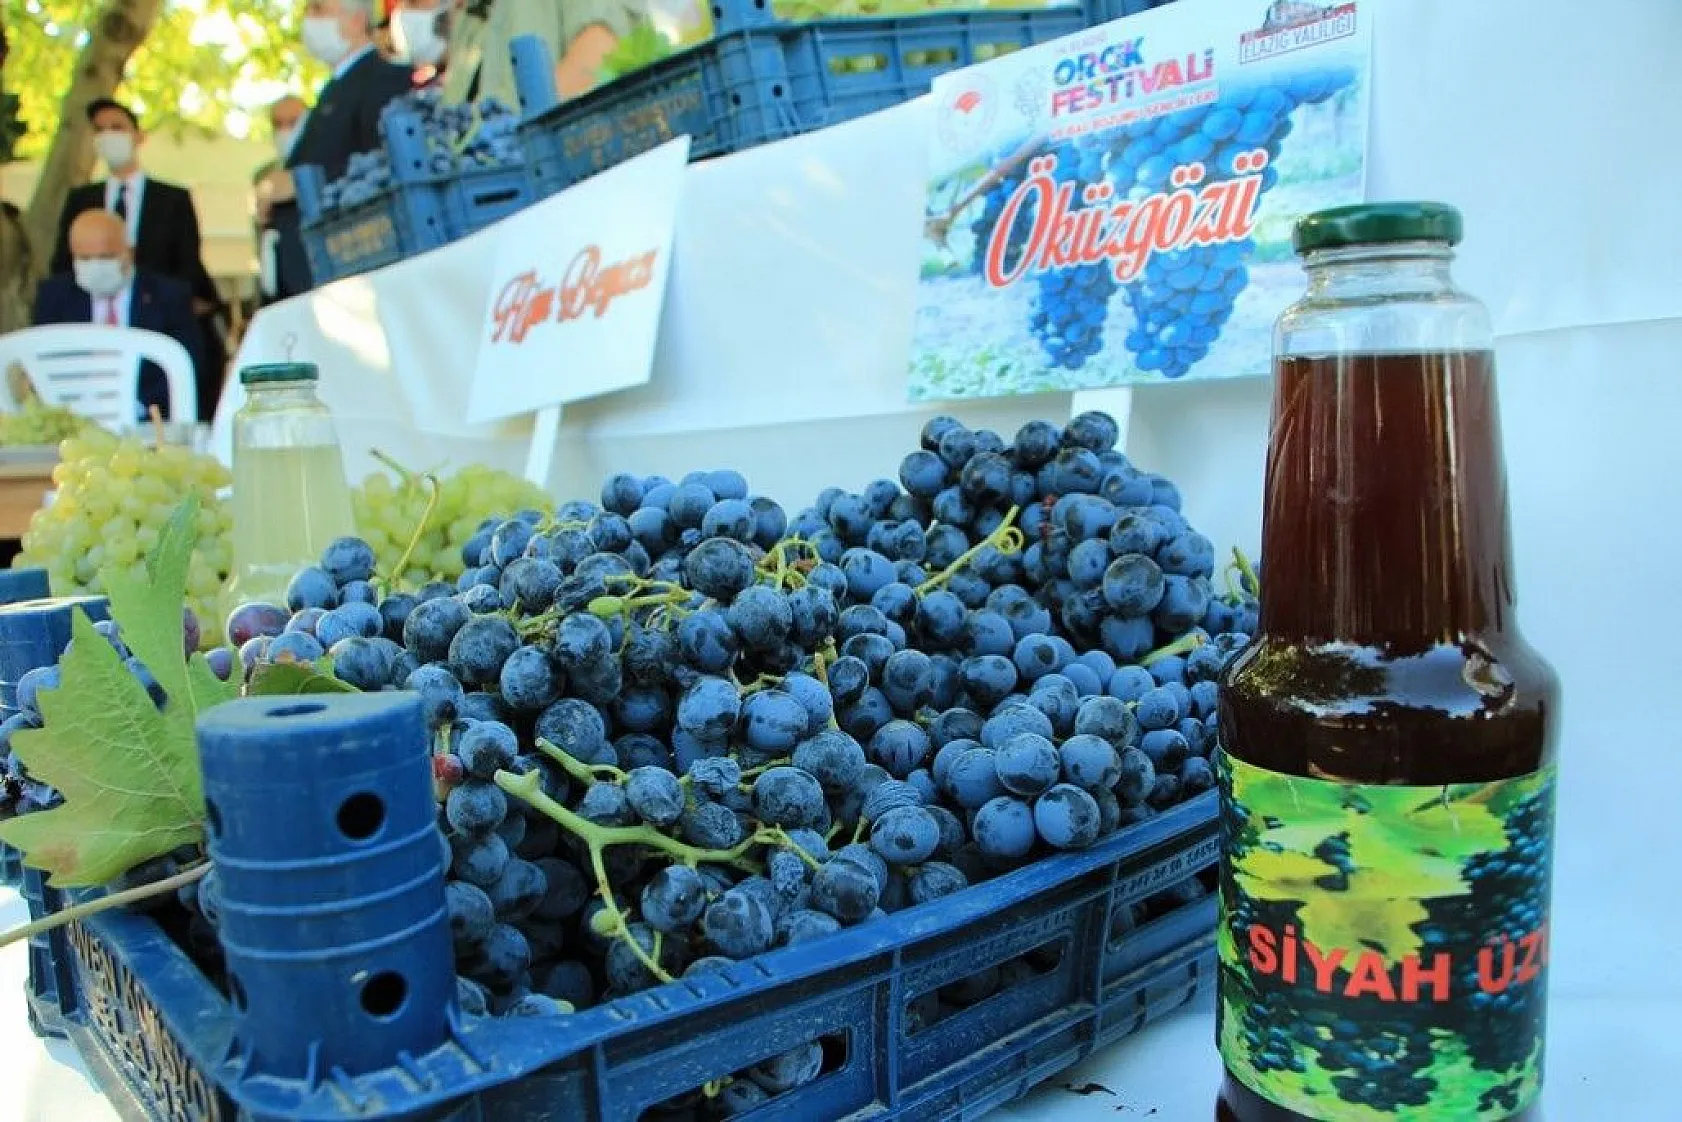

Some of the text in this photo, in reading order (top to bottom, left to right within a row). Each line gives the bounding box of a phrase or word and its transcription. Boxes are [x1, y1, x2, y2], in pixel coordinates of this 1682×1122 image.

[1051, 47, 1214, 117] FESTİVALİ
[986, 151, 1267, 287] Öküzgözü
[1248, 922, 1452, 1002] SİYAH
